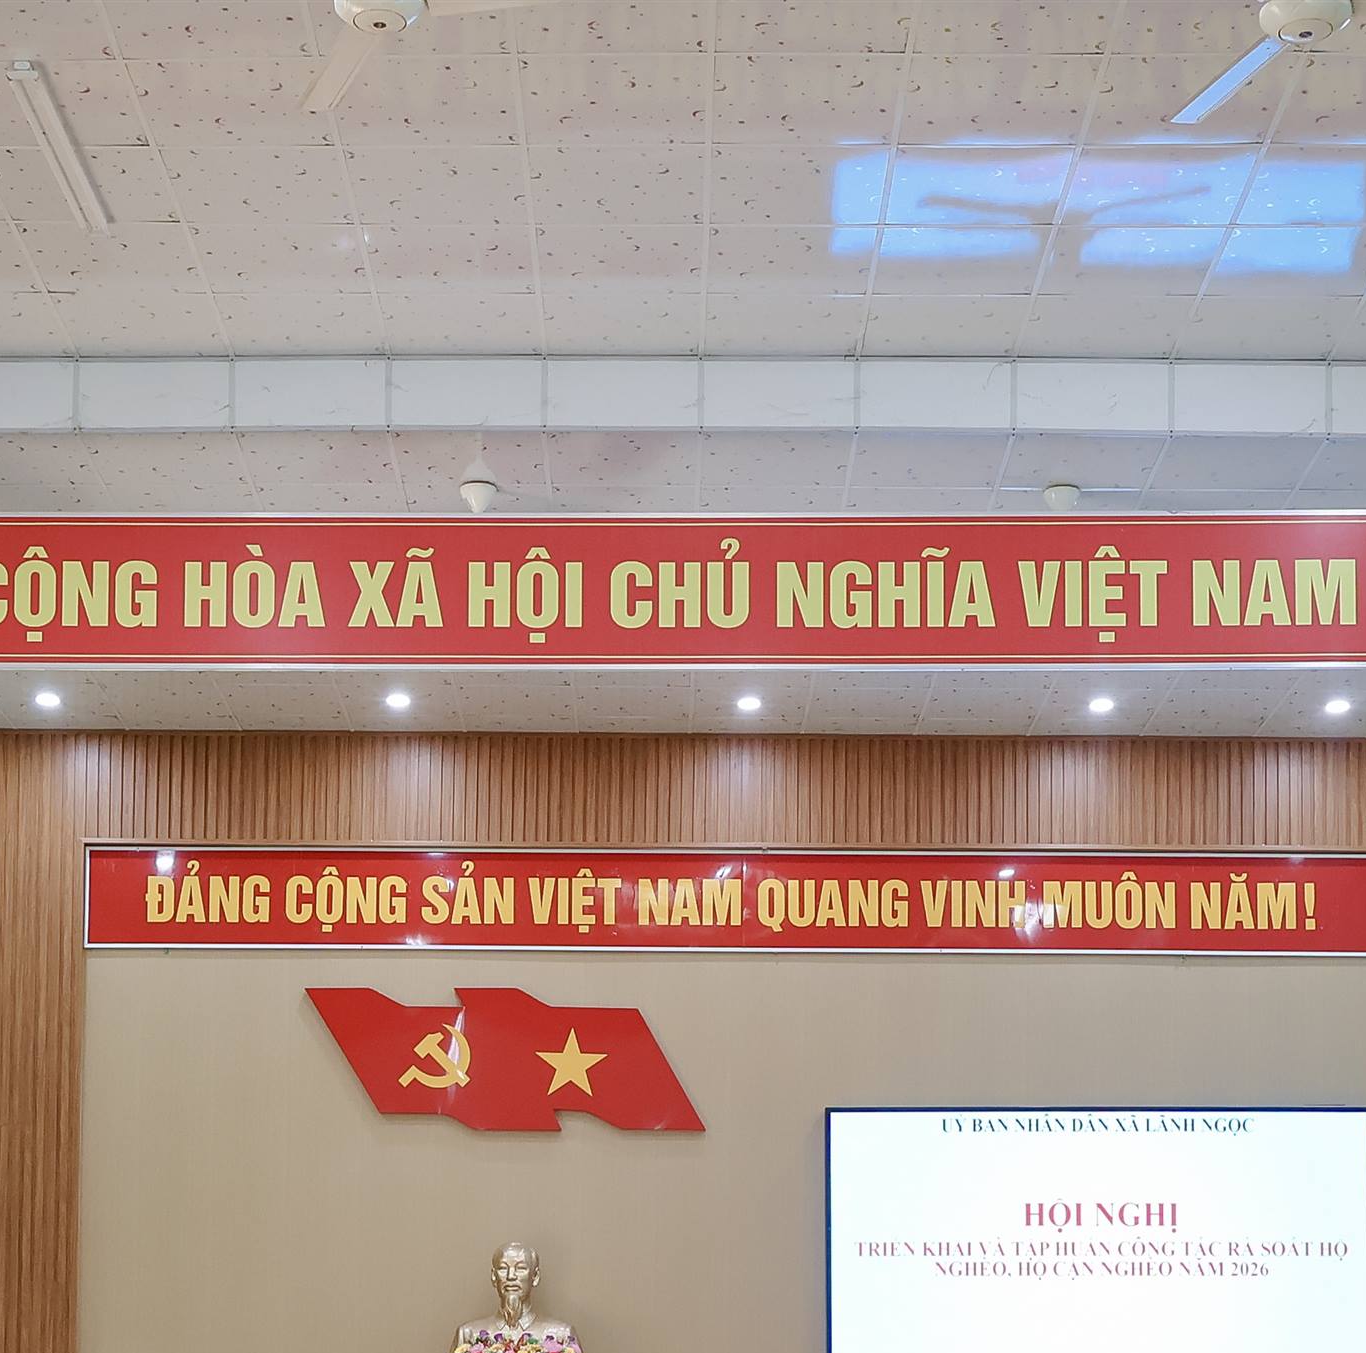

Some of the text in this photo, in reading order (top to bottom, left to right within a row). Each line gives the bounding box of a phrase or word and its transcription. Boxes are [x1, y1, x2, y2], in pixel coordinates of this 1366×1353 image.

[184, 545, 325, 628] HÒA
[348, 548, 443, 627] XÃ
[468, 547, 582, 643] HỘI
[611, 538, 749, 628] CHỦ
[777, 547, 995, 628] NGHĨA
[1018, 546, 1167, 642] VIỆT
[1193, 559, 1356, 626] NAM
[145, 860, 1316, 933] ĐẢNG CỘNG SẢN VIỆT NAM QUANG VINH MUÔN NĂM!
[972, 1113, 1256, 1137] BAN NHÂN DÂN XÃ LÃNH NGỌC
[1025, 1198, 1178, 1233] HỘI NGHỊ
[922, 1241, 973, 1257] KHAI
[1117, 1236, 1176, 1257] CÔNG
[1230, 1261, 1270, 1277] 2026
